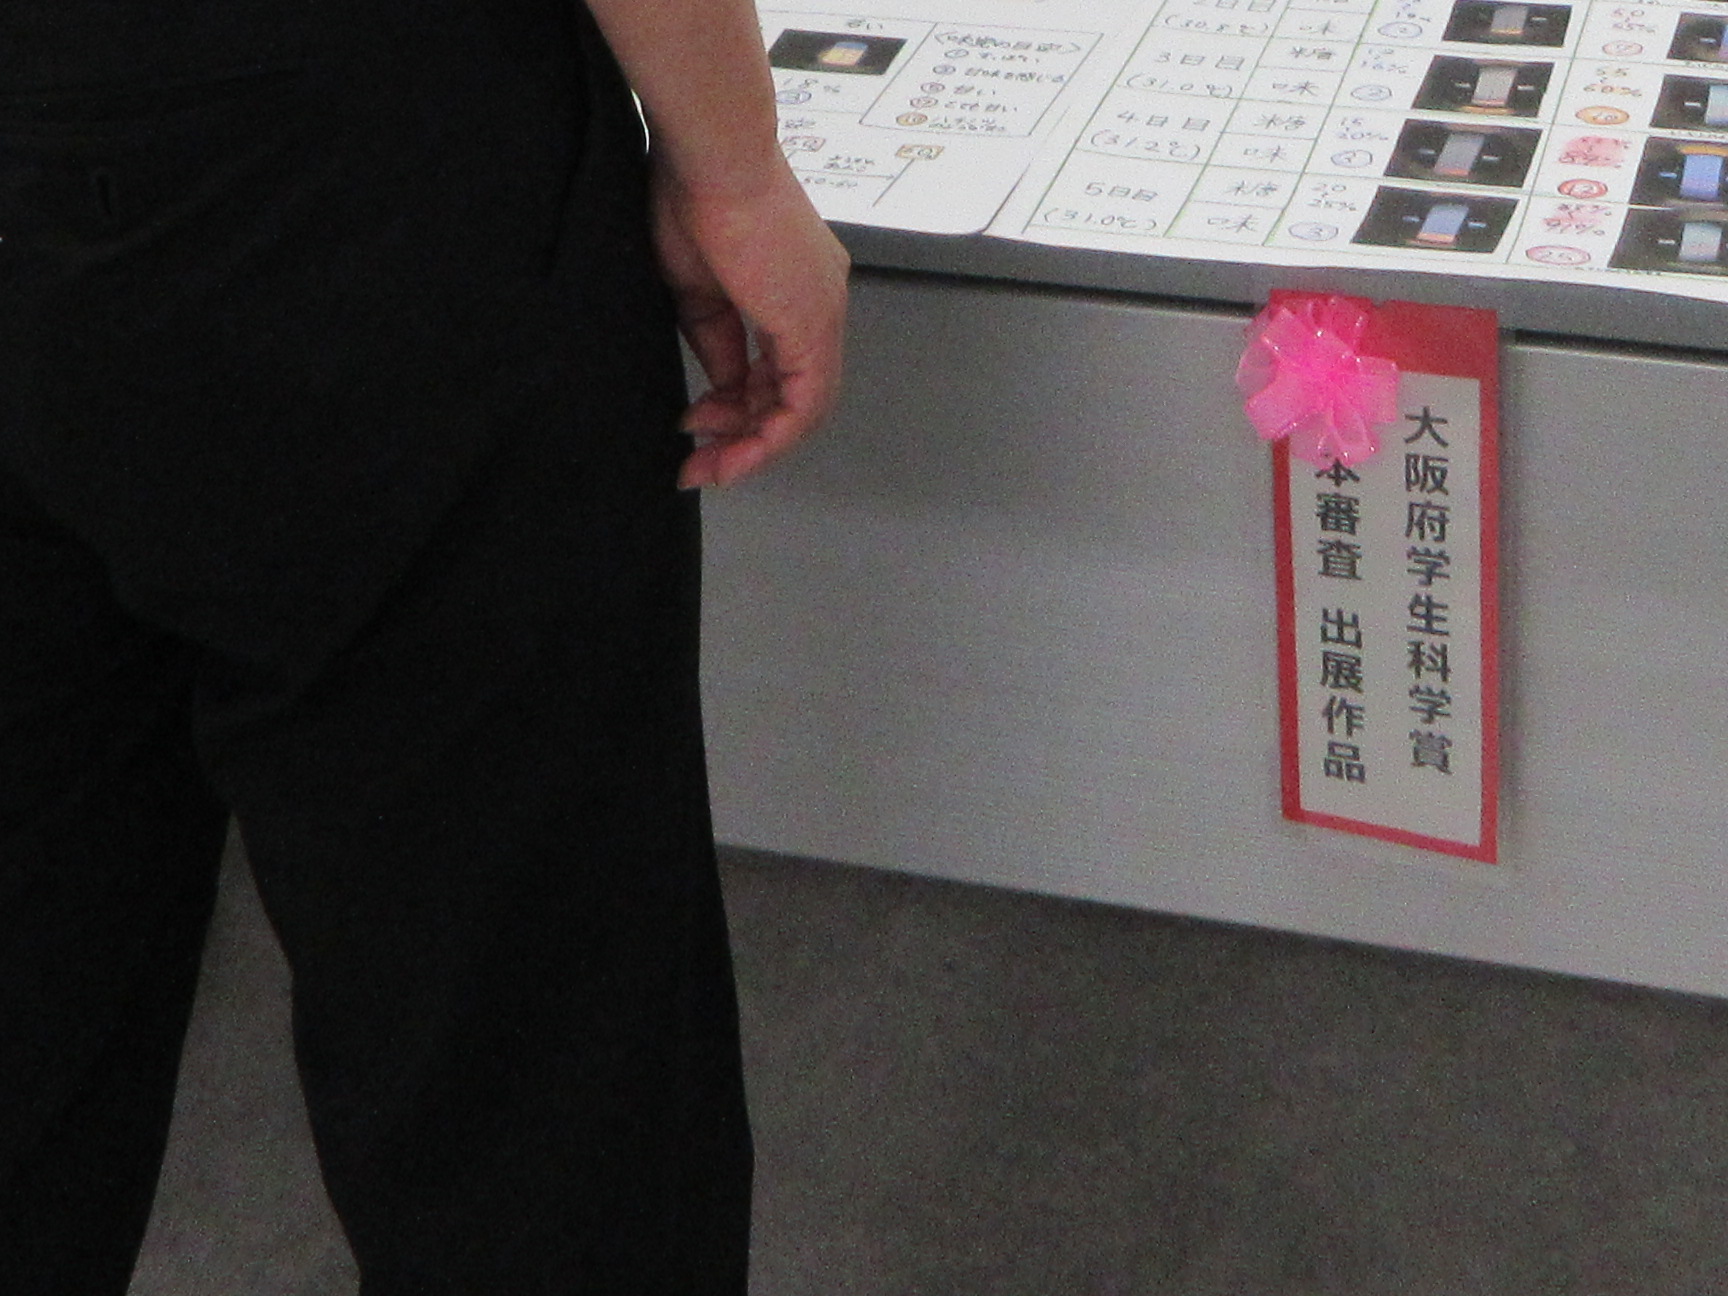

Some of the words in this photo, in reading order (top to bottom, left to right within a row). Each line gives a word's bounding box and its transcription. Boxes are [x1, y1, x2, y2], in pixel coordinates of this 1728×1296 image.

[1320, 608, 1367, 785] 出展作品
[1403, 405, 1452, 777] 大阪府学生科学賞
